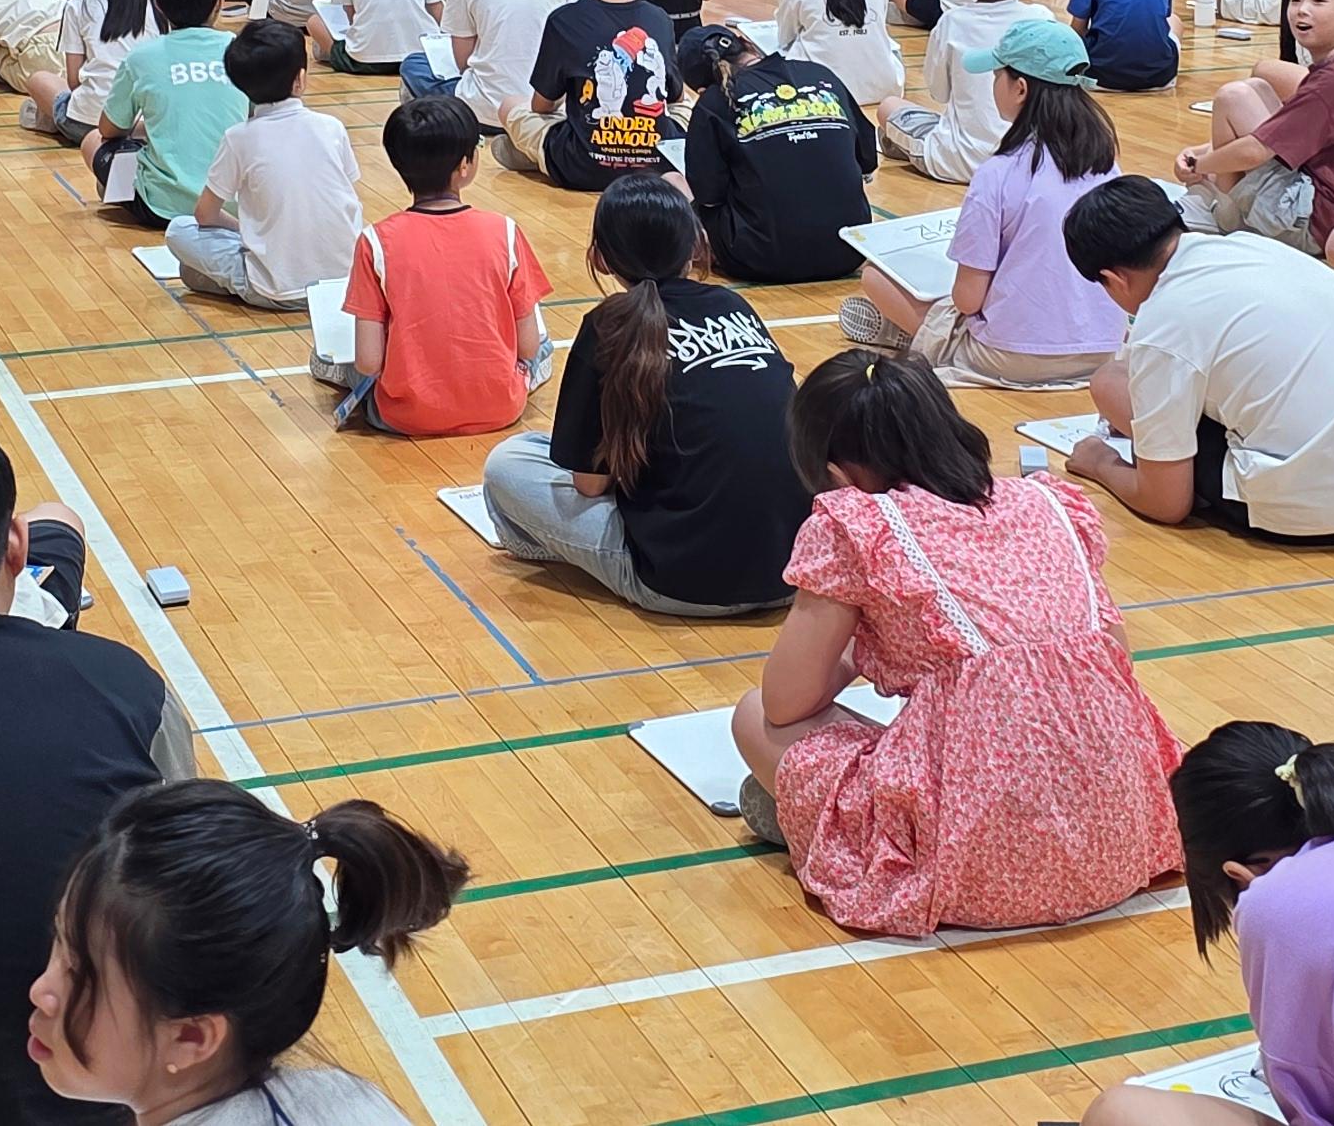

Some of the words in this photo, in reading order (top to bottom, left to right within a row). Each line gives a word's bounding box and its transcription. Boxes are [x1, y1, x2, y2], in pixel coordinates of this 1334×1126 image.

[170, 60, 231, 86] BBQ
[599, 115, 657, 132] UNDER
[590, 129, 662, 148] ARMOUR
